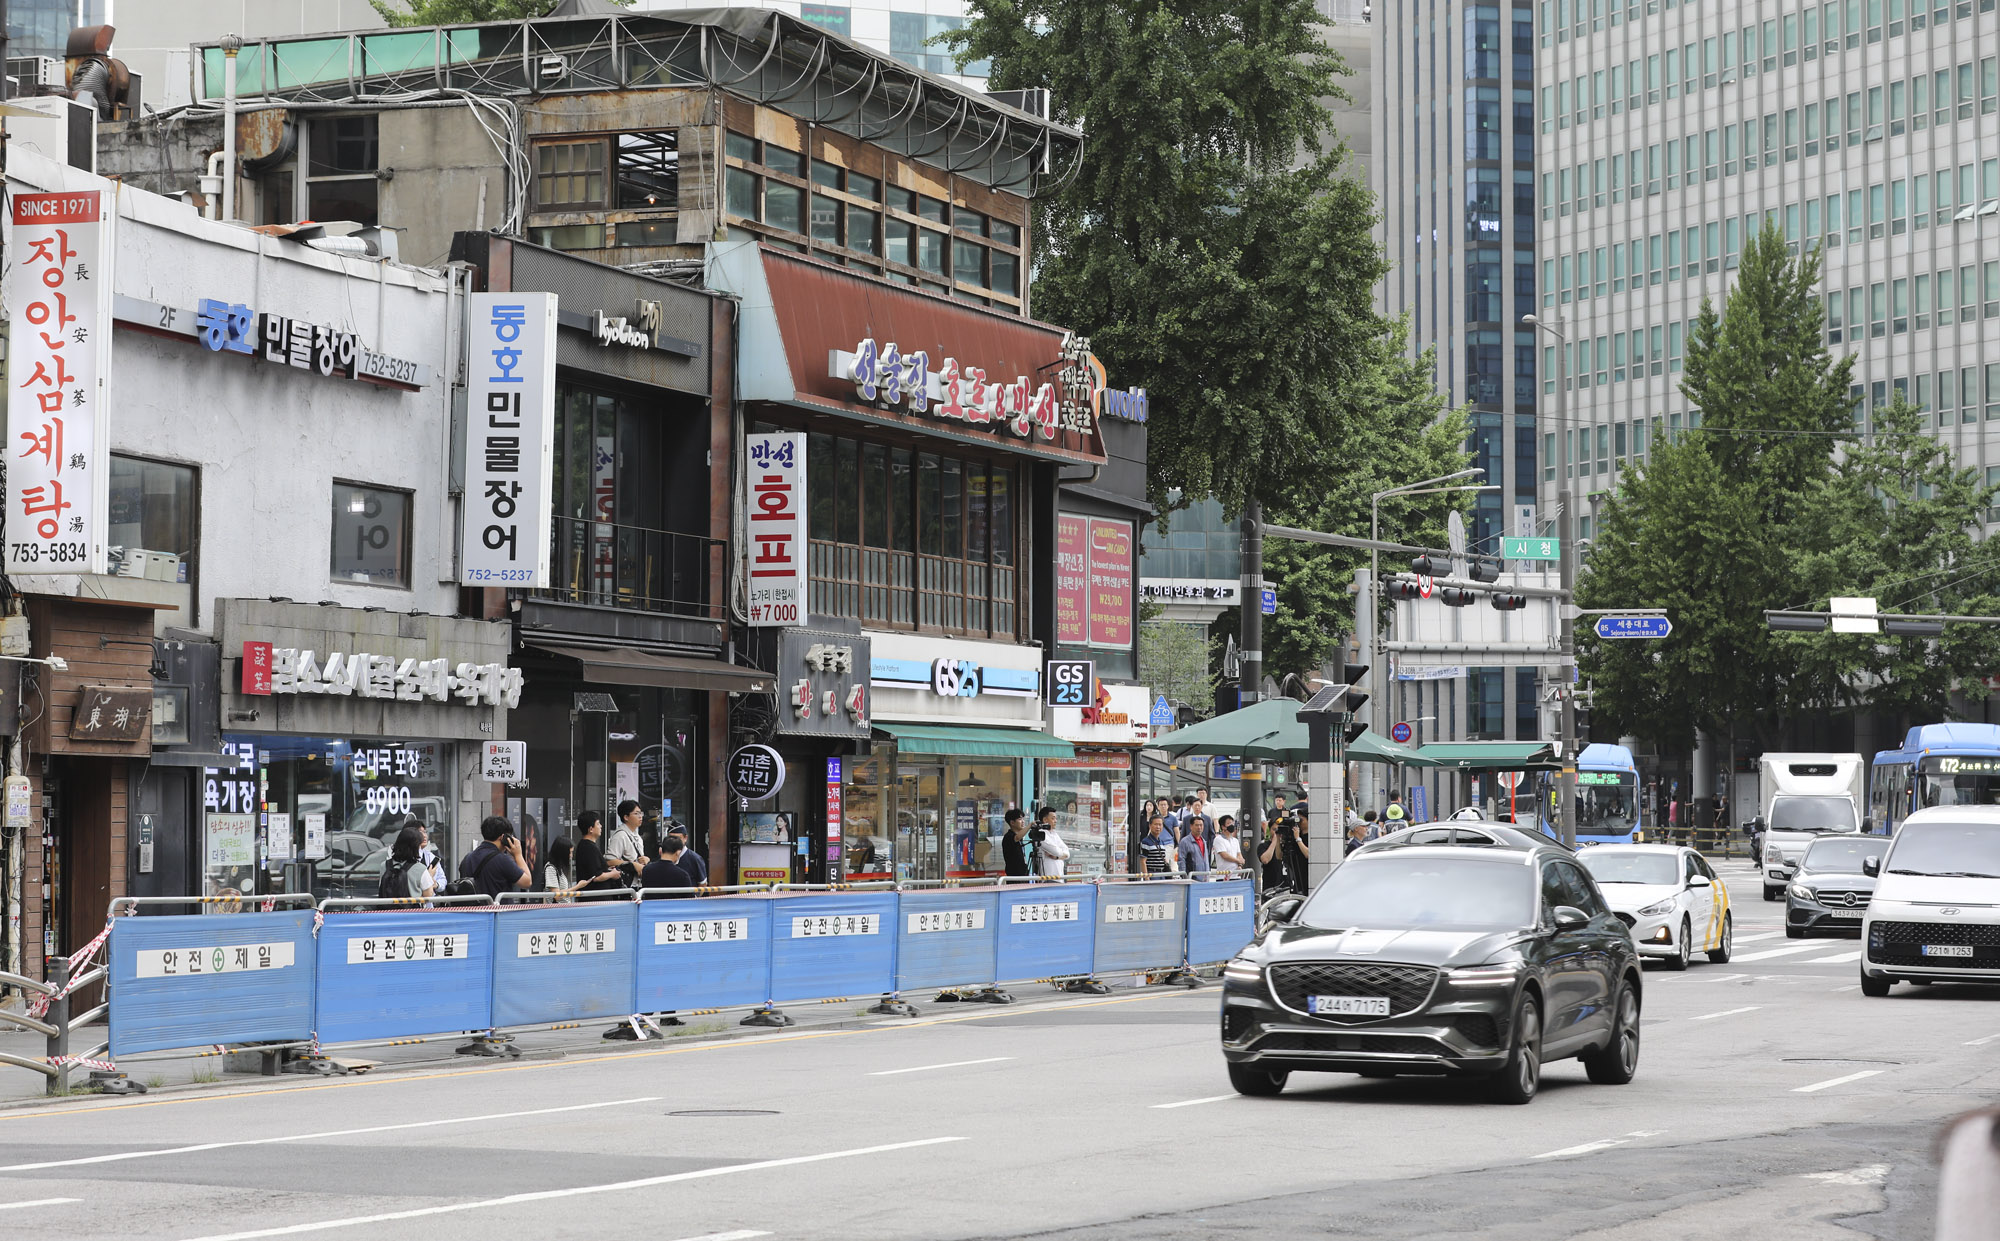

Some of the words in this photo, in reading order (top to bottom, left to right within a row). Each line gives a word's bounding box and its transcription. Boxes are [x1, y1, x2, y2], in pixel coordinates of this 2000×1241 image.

[20, 200, 57, 217] SINCE
[61, 198, 93, 216] 1971
[1480, 220, 1499, 232] 발레
[159, 306, 177, 328] 2F
[200, 299, 254, 353] 동호
[260, 313, 358, 378] 민물장어
[364, 352, 417, 384] 752-5237
[490, 305, 526, 384] 동호
[19, 229, 76, 540] 장안삼계탕
[1104, 386, 1149, 423] world
[751, 440, 794, 468] 만선
[485, 391, 522, 561] 민물장어
[751, 475, 796, 577] 호프
[11, 543, 87, 563] 753-5834
[1516, 541, 1551, 556] 시청
[468, 568, 533, 582] 752-5237
[751, 590, 771, 600] 노가리
[1154, 586, 1205, 598] 이비인후과
[1213, 586, 1227, 598] 2F
[1600, 624, 1609, 632] 85
[1617, 620, 1650, 629] 세종대로
[1658, 623, 1667, 631] 91
[933, 658, 979, 698] GS25
[1056, 665, 1084, 683] GS
[1056, 684, 1083, 703] 25
[1099, 708, 1128, 724] telecom
[353, 749, 393, 776] 순대국
[395, 749, 419, 778] 포장
[491, 757, 511, 765] 순대
[739, 753, 771, 770] 교촌
[1940, 759, 1959, 773] 472
[486, 770, 516, 778] 육개장
[737, 770, 769, 786] 치킨
[205, 779, 255, 814] 육개장
[366, 786, 411, 815] 8900
[1019, 905, 1039, 921] 안전
[1052, 903, 1071, 919] 제일
[1115, 905, 1134, 921] 안전
[1147, 903, 1166, 919] 제일
[1204, 898, 1219, 913] 안전
[1225, 895, 1239, 911] 제일
[802, 918, 828, 936] 안전
[846, 916, 871, 934] 제일
[919, 914, 940, 931] 안전
[954, 908, 974, 928] 제일
[666, 921, 693, 943] 안전
[711, 920, 740, 941] 제일
[363, 939, 397, 960] 안전
[422, 936, 455, 957] 제일
[530, 934, 558, 955] 안전
[579, 931, 605, 952] 제일
[1952, 948, 1972, 956] 1253
[162, 952, 202, 974] 안전
[234, 945, 272, 969] 제일
[1354, 1000, 1387, 1013] 7175
